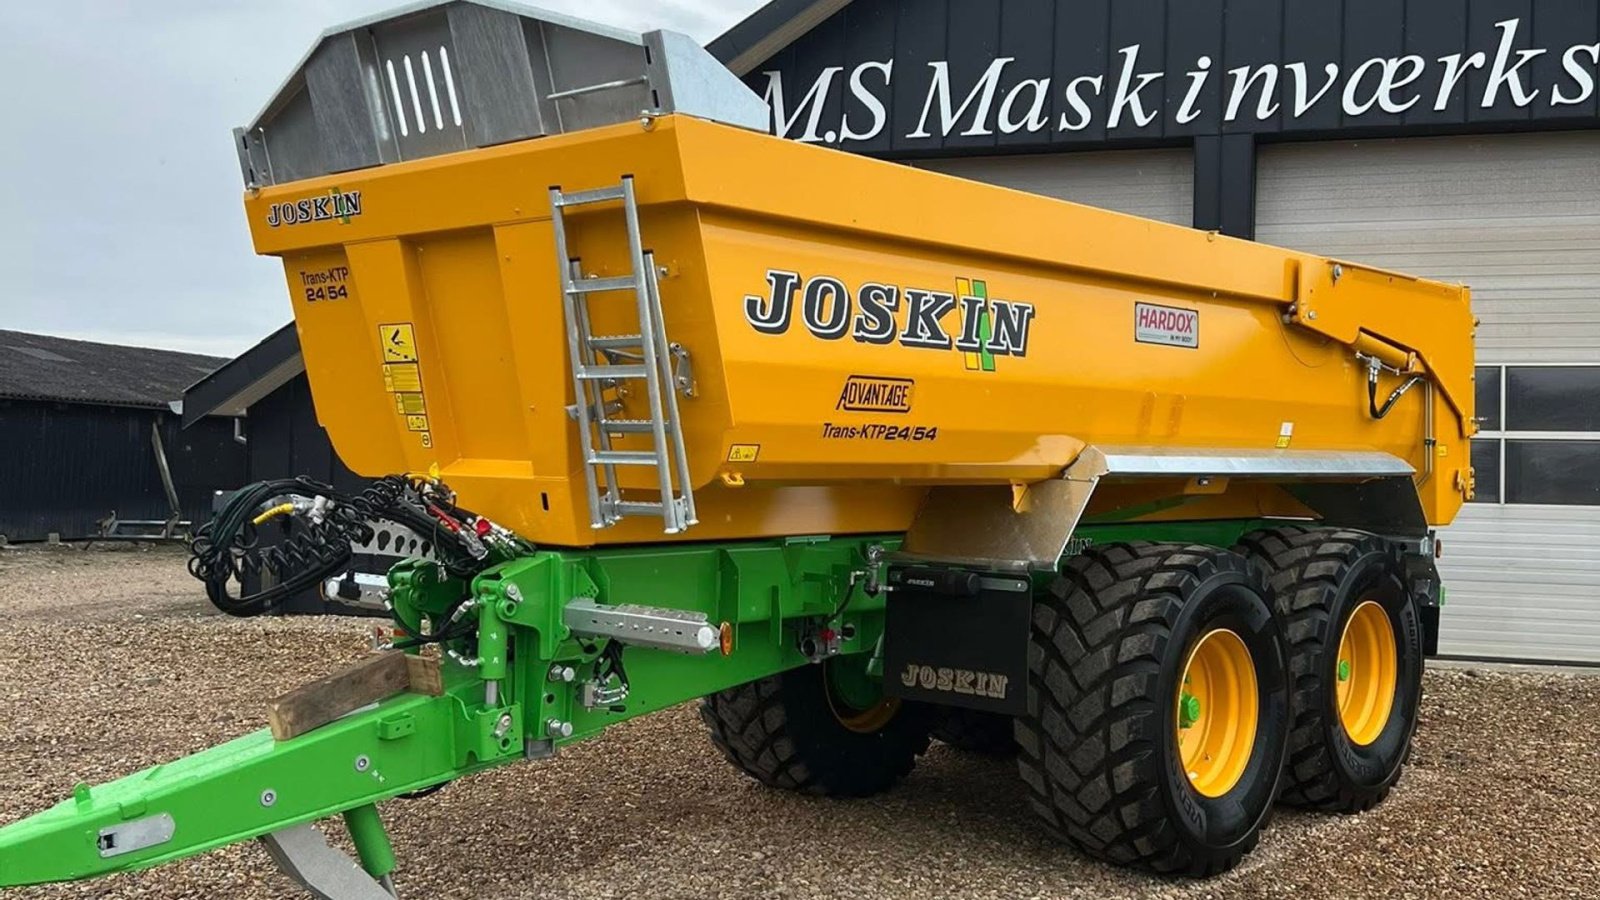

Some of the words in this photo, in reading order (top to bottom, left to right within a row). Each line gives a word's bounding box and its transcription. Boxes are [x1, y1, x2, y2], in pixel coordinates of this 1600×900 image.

[267, 191, 362, 227] JOSKIN
[300, 266, 349, 286] Trans-KTP
[744, 269, 1035, 356] JOSKIN
[1139, 307, 1193, 333] HARDOX
[835, 382, 909, 410] ADVANTAGE
[901, 664, 1008, 699] JOSKIN
